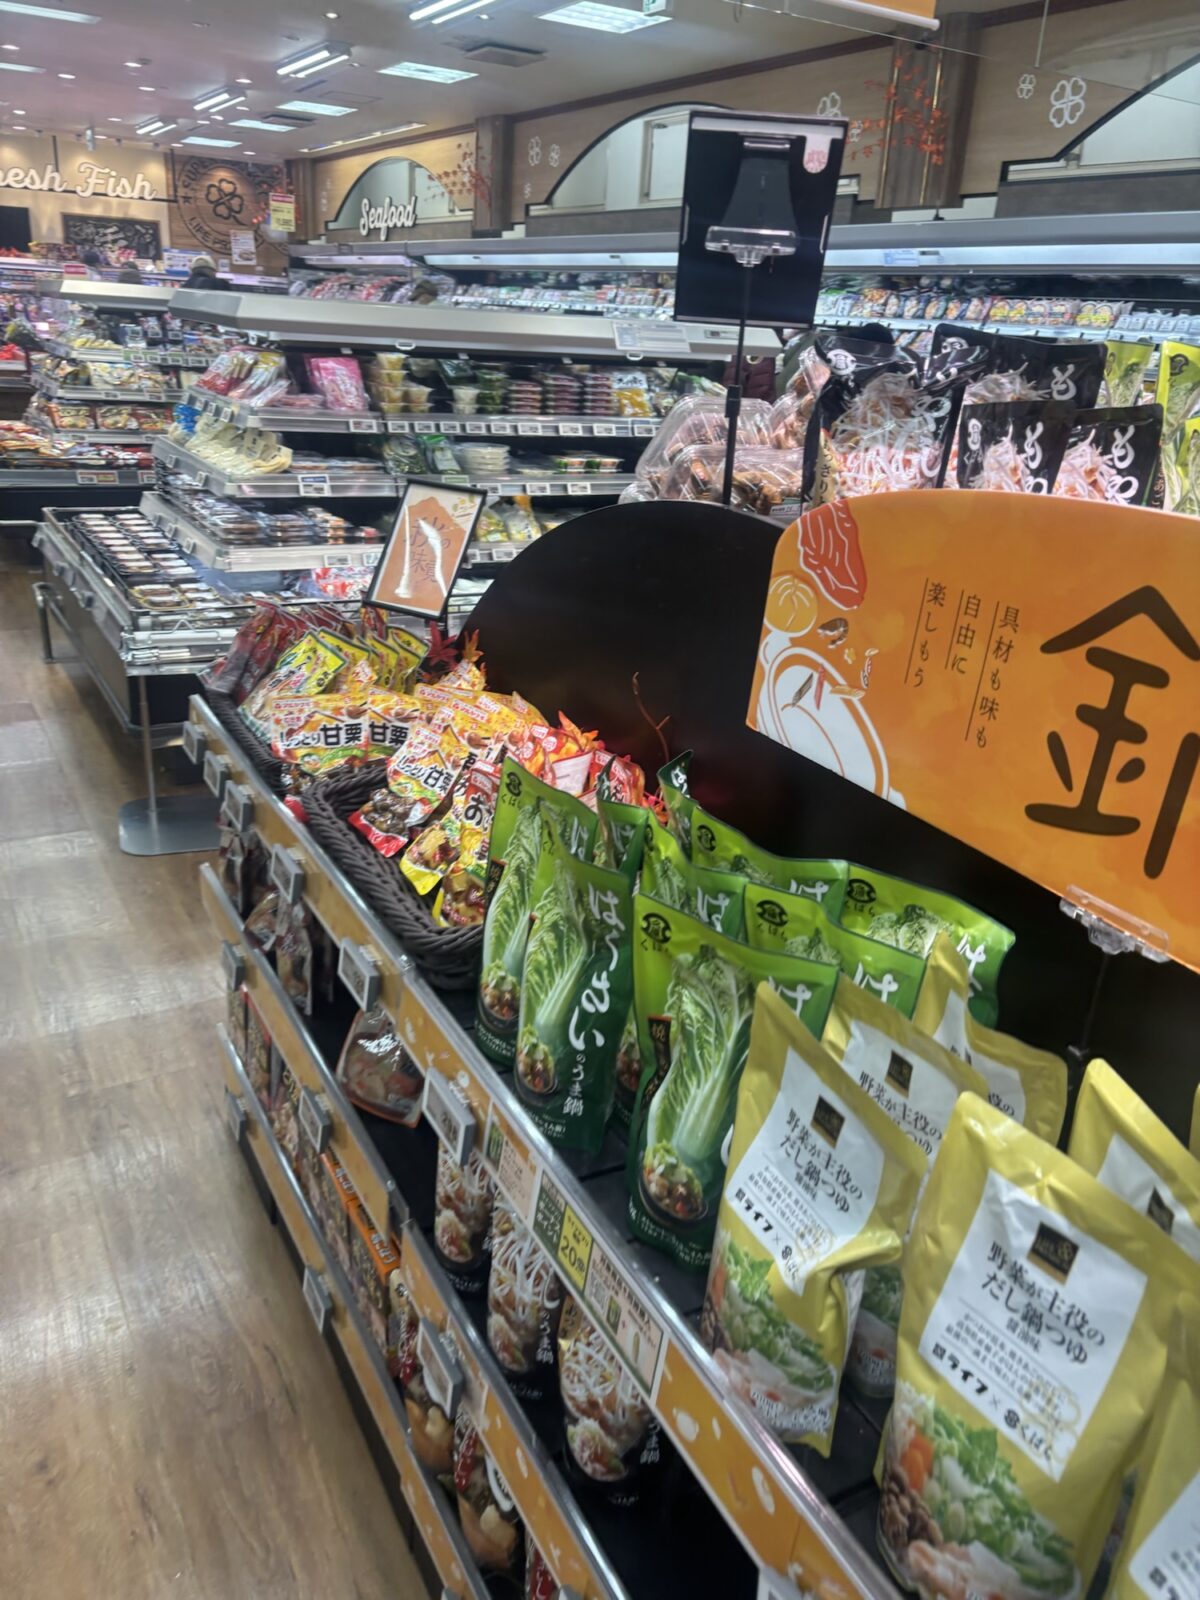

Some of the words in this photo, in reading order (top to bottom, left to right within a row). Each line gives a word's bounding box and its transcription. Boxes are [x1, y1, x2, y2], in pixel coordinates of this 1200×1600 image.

[0, 164, 67, 193] esh
[76, 161, 156, 198] Fish
[360, 196, 417, 241] Seafood
[913, 582, 947, 687] 楽しもう
[951, 594, 981, 674] 自由に
[976, 605, 1020, 748] 具材も味も
[279, 722, 362, 747] しっとり甘栗
[369, 721, 409, 746] 甘栗
[859, 1070, 943, 1141] 野菜が主役の
[780, 1133, 850, 1215] だし鍋つゆ
[786, 1107, 864, 1200] 野菜が主役の
[748, 1201, 774, 1233] ライフ
[982, 1268, 1089, 1367] だし鍋つゆ
[987, 1240, 1106, 1349] 野菜が主役の
[948, 1353, 989, 1395] ライフ
